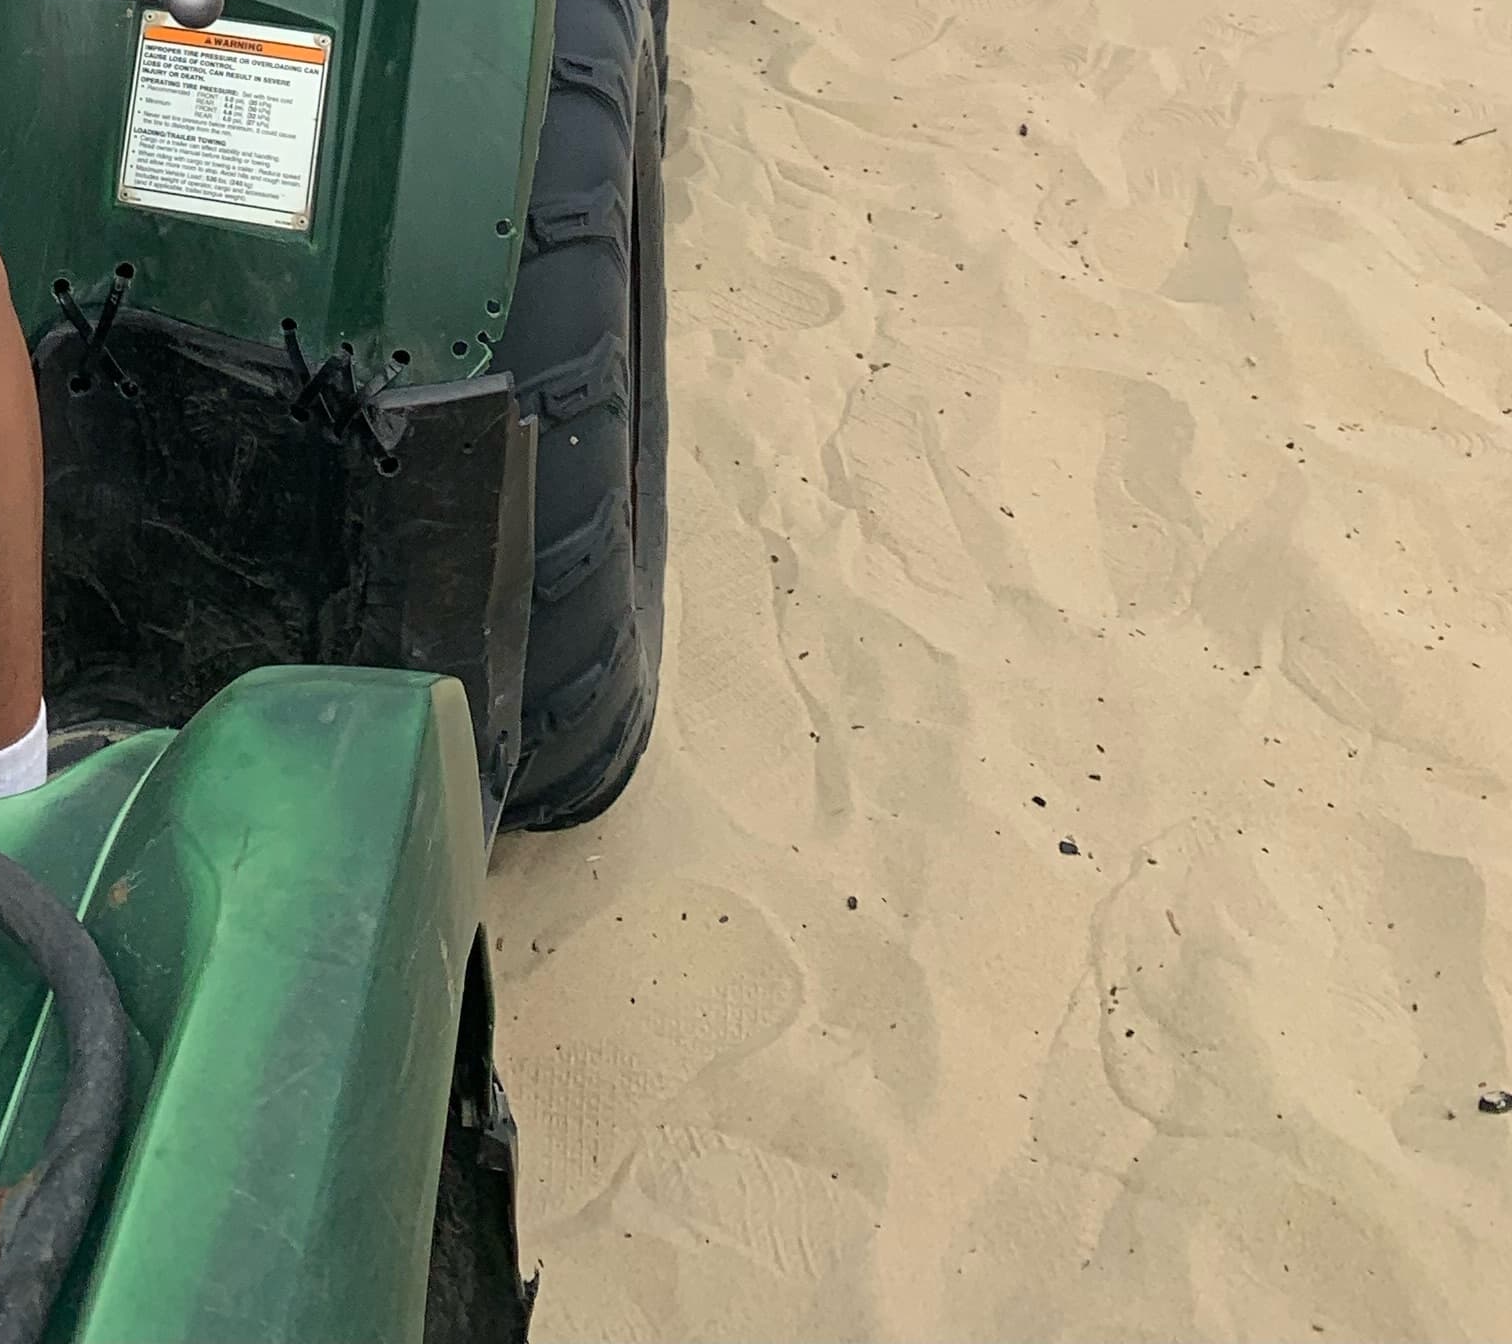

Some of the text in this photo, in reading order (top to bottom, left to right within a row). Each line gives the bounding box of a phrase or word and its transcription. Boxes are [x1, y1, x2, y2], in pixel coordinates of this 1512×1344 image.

[213, 37, 263, 52] WARNING
[143, 51, 166, 60] CAUSE
[168, 55, 187, 63] LOSS
[183, 49, 198, 57] TIRE
[200, 52, 237, 62] PRESSURE
[251, 59, 302, 72] OVERLOADING
[141, 67, 166, 75] INJURY
[142, 59, 160, 67] LOSS
[174, 64, 207, 74] CONTROL
[225, 71, 251, 80] RESULT
[263, 77, 290, 86] SEVERE
[140, 76, 180, 87] OPERATING
